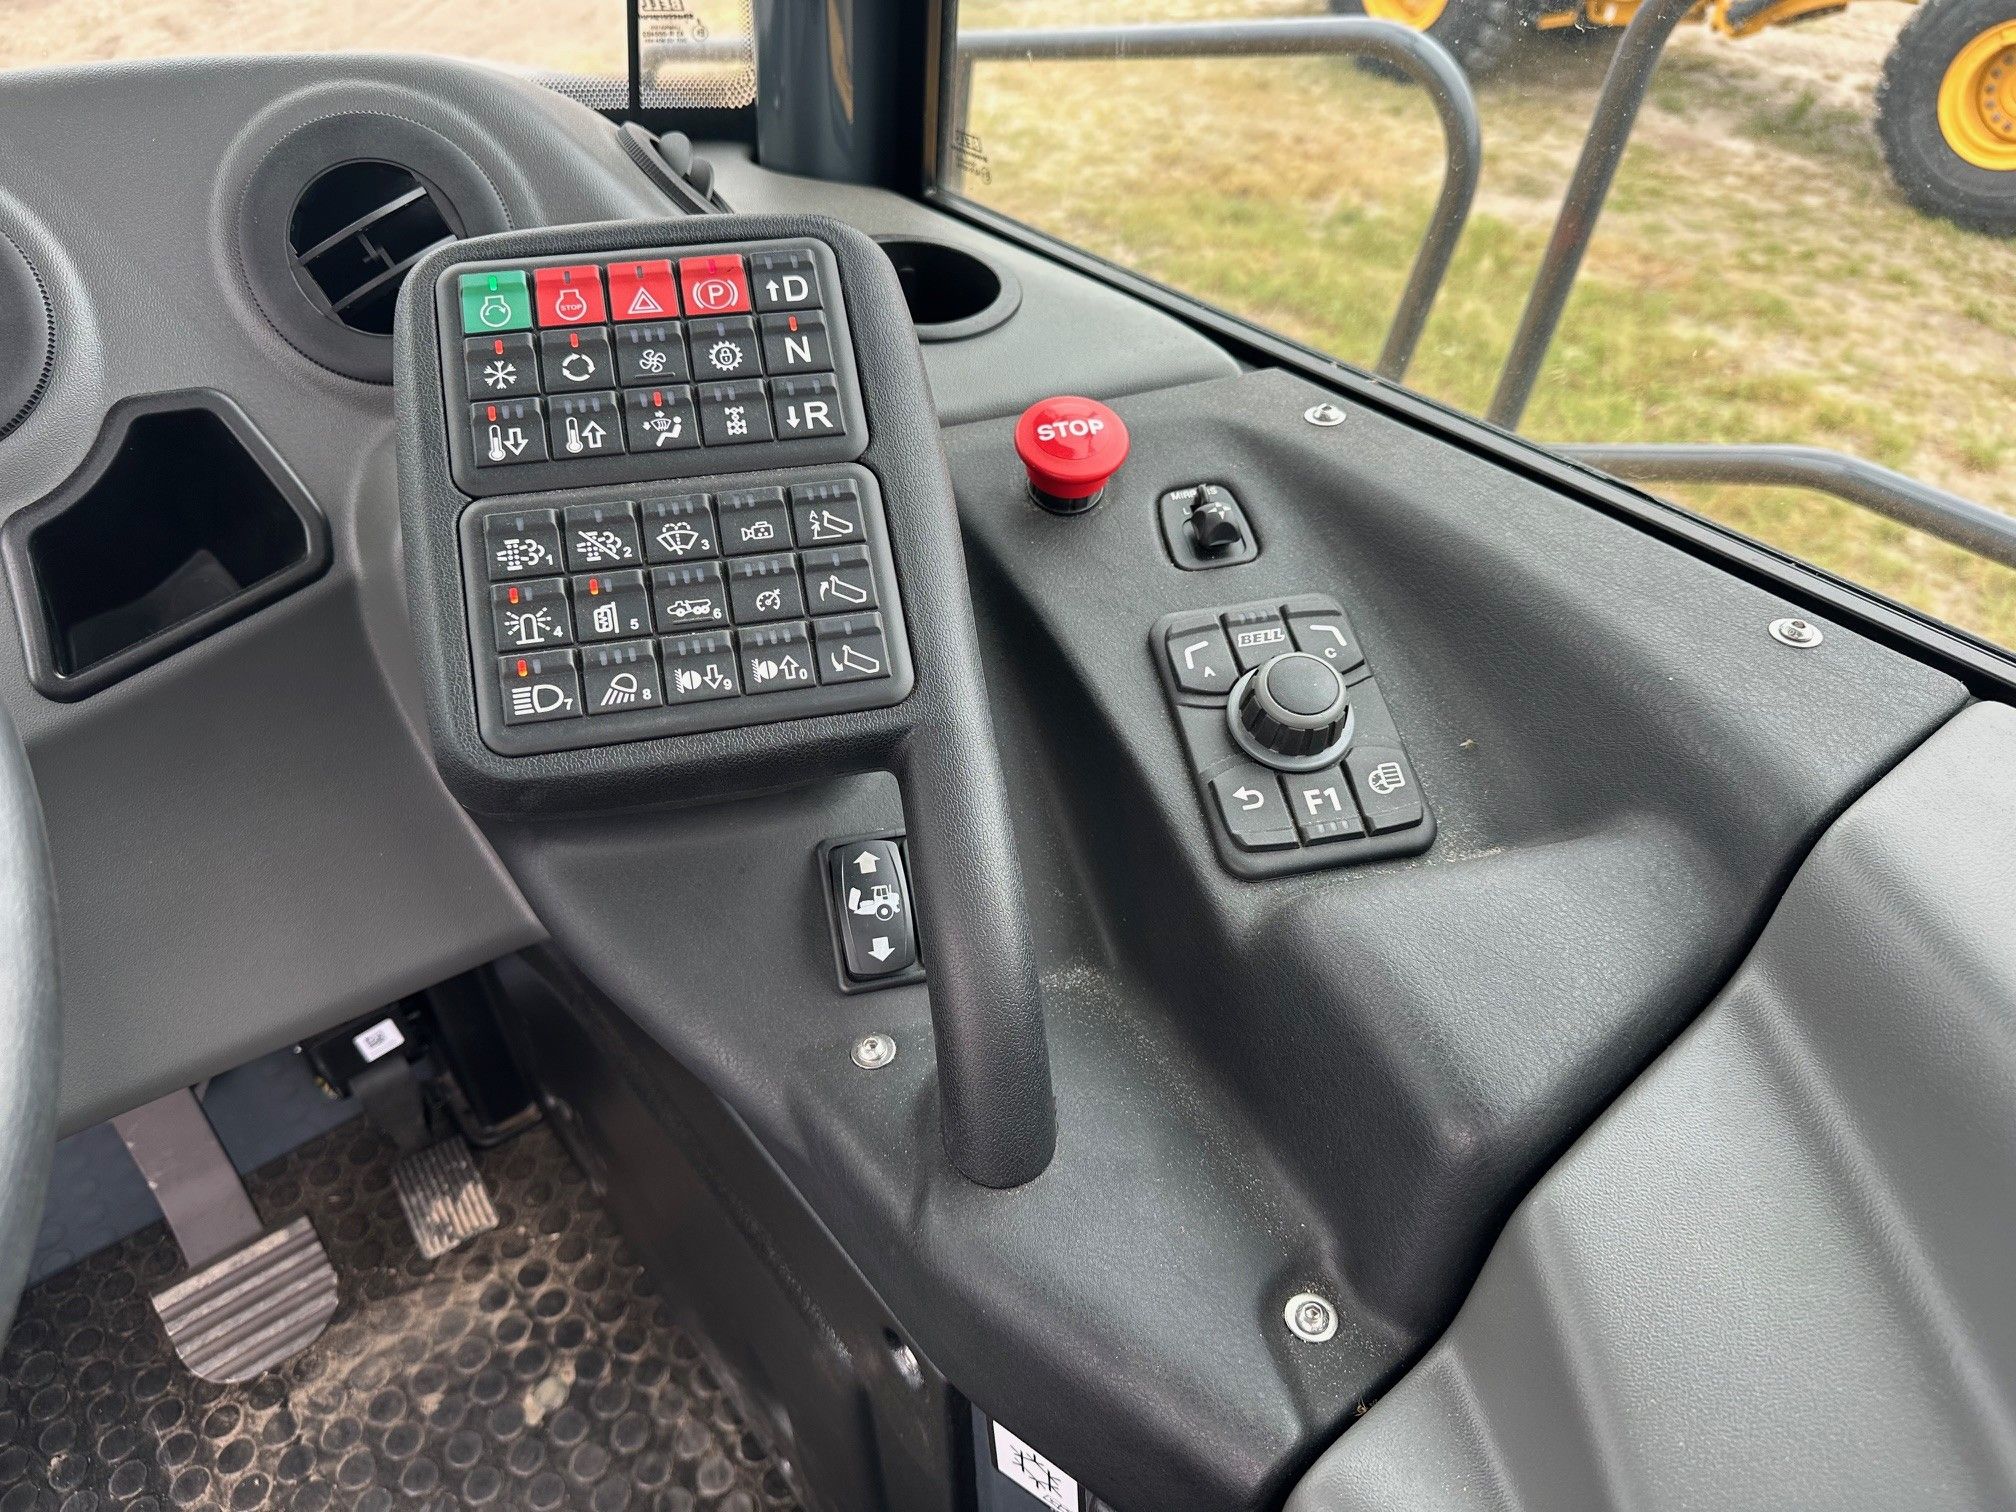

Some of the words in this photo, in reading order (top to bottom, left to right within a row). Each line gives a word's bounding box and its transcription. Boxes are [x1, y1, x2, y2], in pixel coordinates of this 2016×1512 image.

[708, 284, 724, 305] P
[783, 276, 809, 302] D
[560, 304, 582, 312] STOP
[785, 335, 811, 363] N
[804, 400, 834, 430] R
[1037, 418, 1105, 441] STOP
[700, 538, 711, 551] 3
[622, 546, 633, 559] 2
[545, 553, 555, 566] 1
[712, 607, 722, 620] 6
[630, 618, 640, 630] 5
[552, 625, 564, 638] 4
[1238, 628, 1285, 647] BELL
[1325, 648, 1337, 659] C
[1204, 666, 1217, 678] A
[723, 679, 733, 691] 9
[642, 688, 652, 701] 8
[564, 697, 574, 710] 7
[1303, 787, 1342, 816] F1
